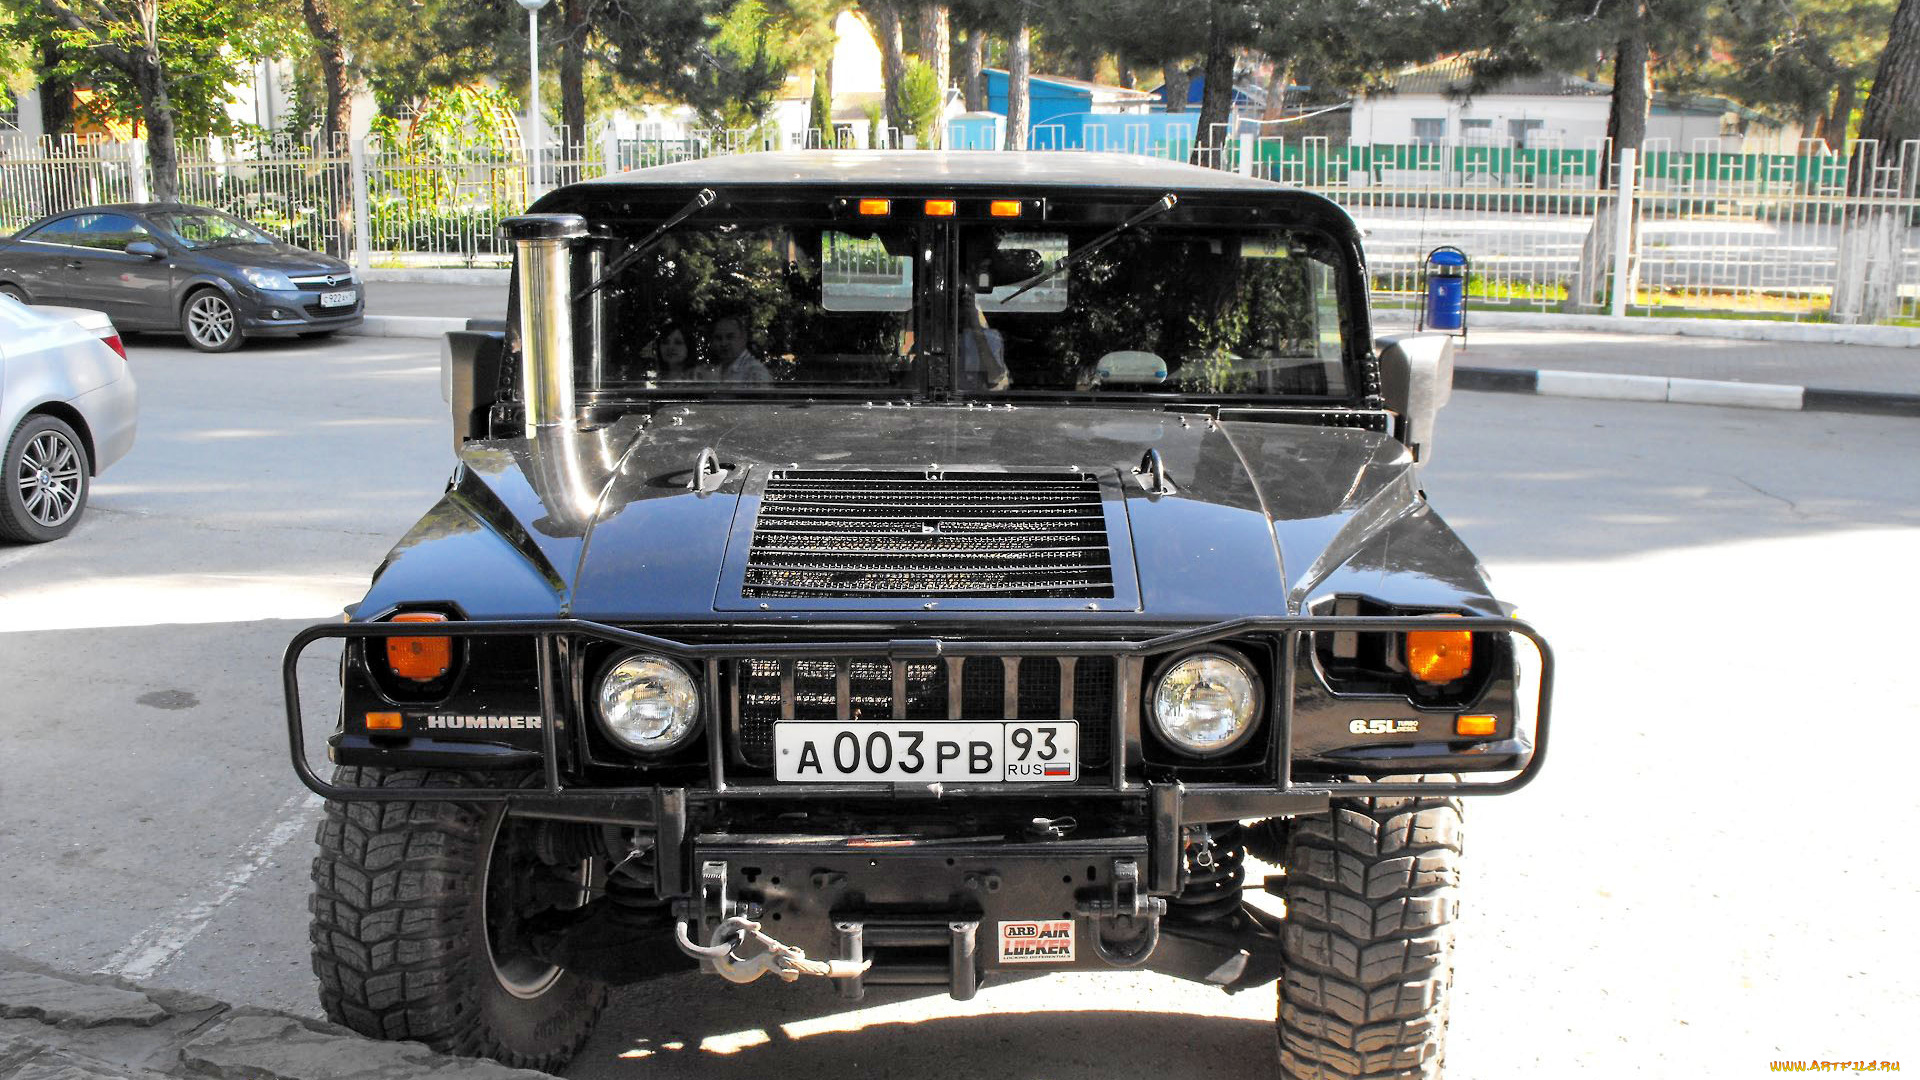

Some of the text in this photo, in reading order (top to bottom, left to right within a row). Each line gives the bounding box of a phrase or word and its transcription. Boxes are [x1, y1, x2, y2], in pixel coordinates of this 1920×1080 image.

[427, 716, 541, 729] HUMMER
[1349, 719, 1397, 734] 6.5L
[1011, 728, 1058, 761] 93
[1008, 764, 1043, 775] RUS
[1008, 923, 1070, 938] ARB AIR
[1004, 940, 1070, 955] LOCKER
